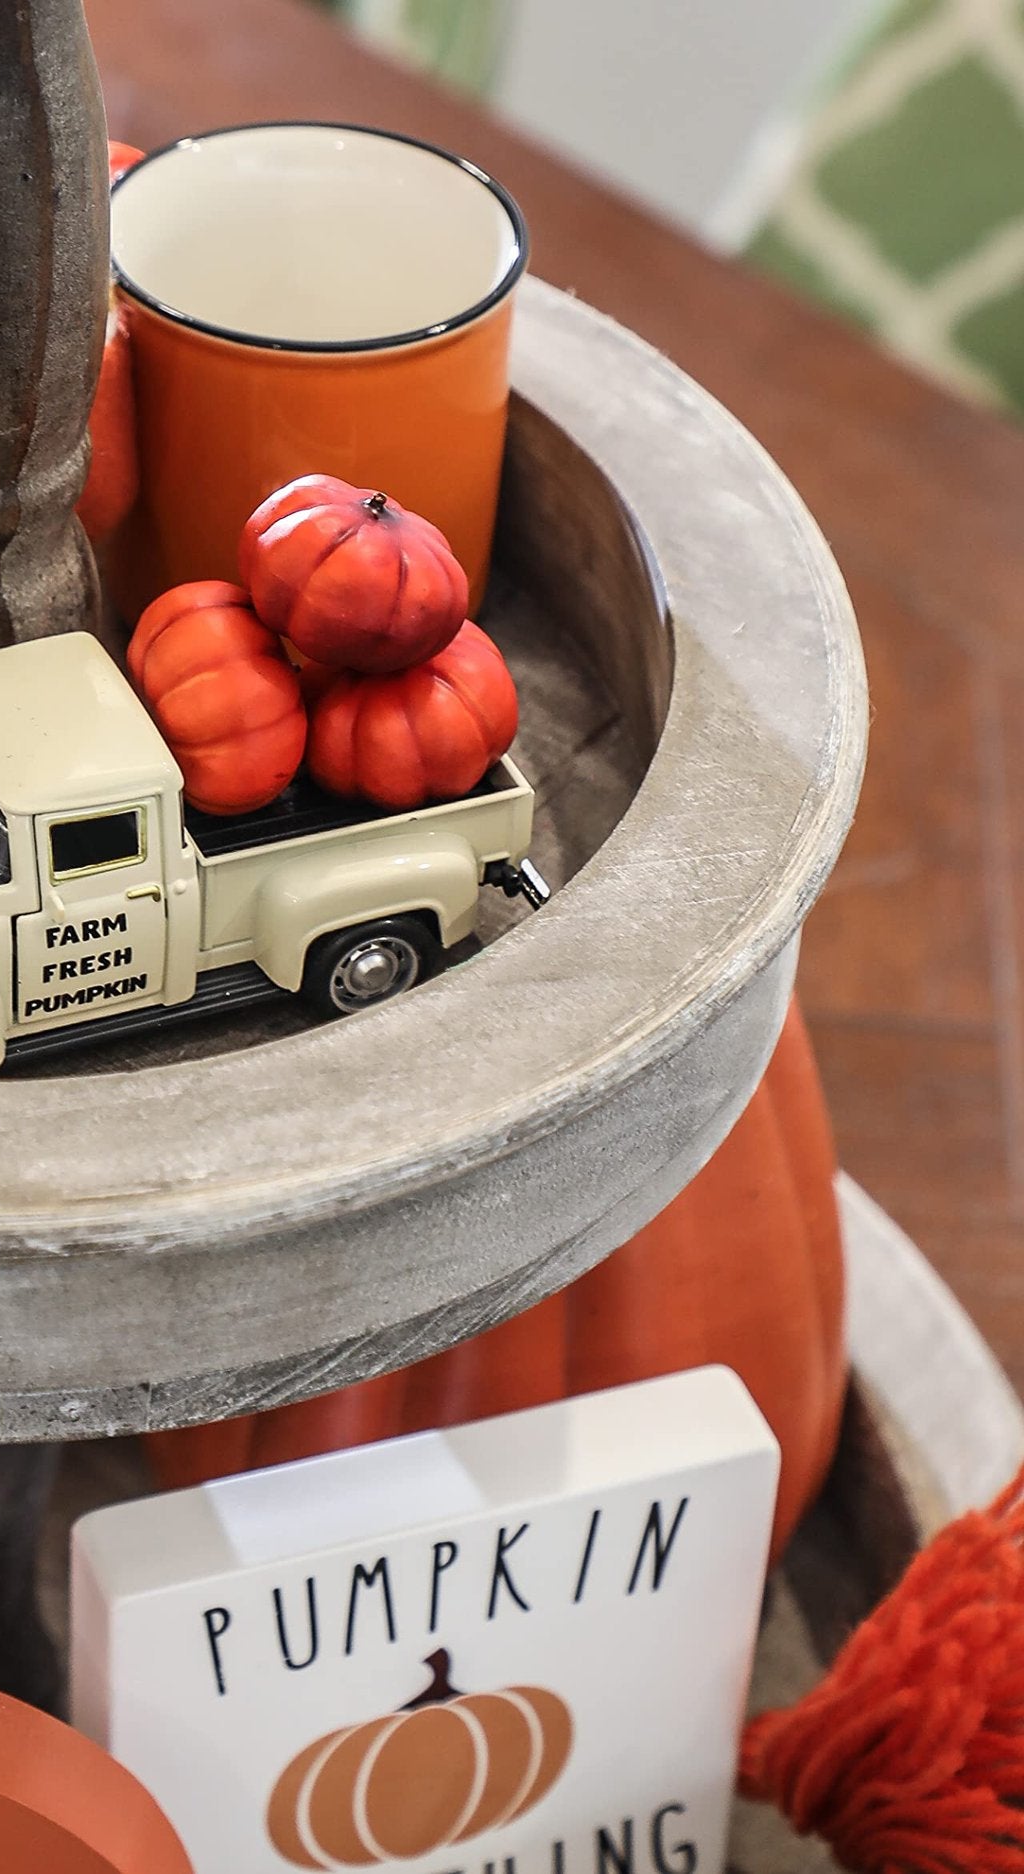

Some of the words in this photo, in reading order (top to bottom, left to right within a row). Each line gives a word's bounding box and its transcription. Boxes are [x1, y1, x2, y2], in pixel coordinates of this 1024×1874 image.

[46, 913, 127, 948] FARM
[43, 947, 131, 984] FRESH
[25, 973, 147, 1016] PUMPKIN
[203, 1497, 689, 1695] PUMPKIN
